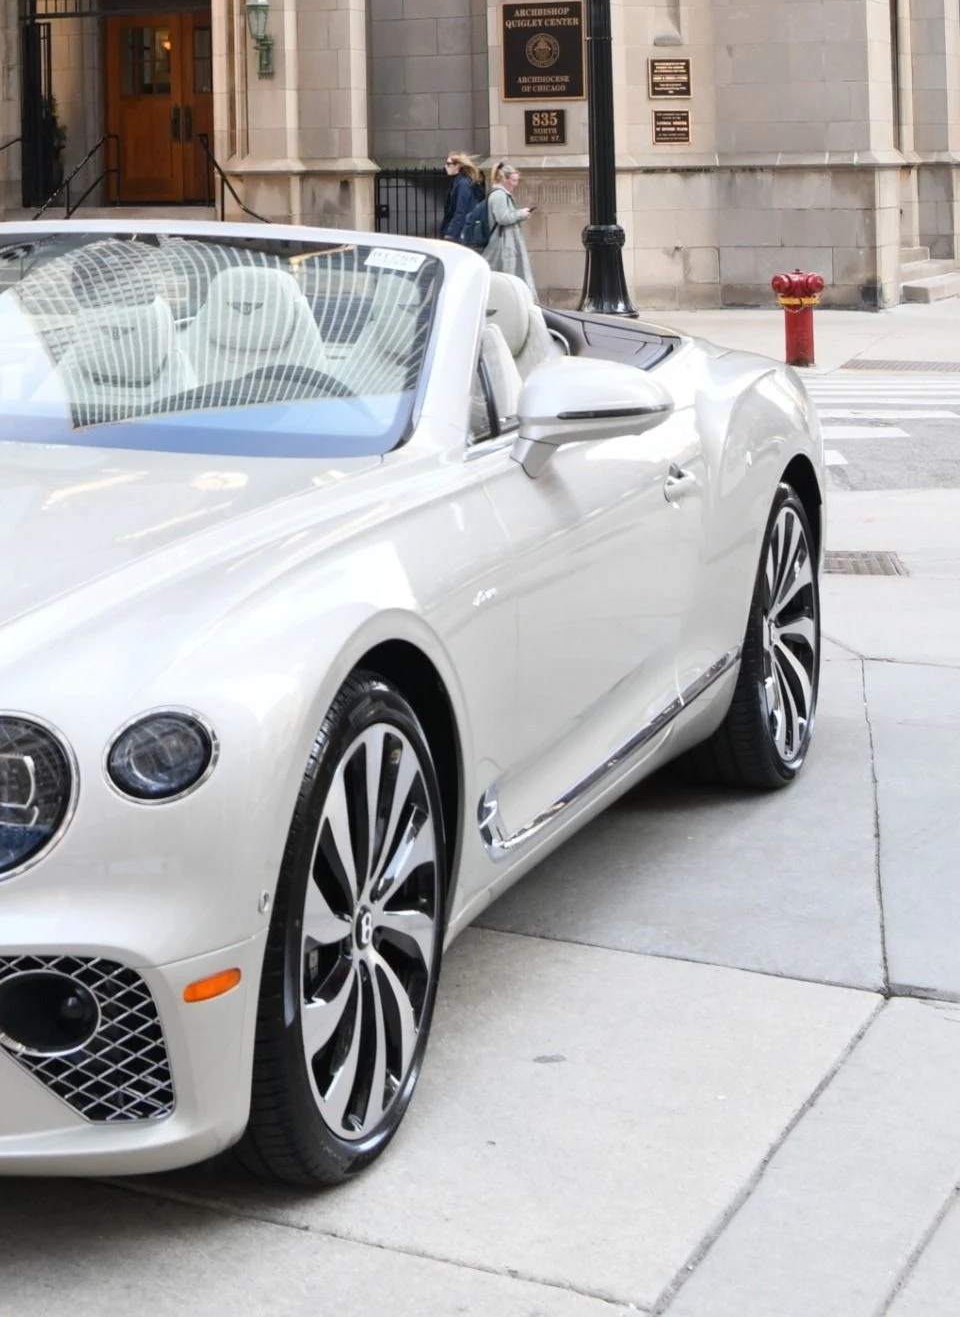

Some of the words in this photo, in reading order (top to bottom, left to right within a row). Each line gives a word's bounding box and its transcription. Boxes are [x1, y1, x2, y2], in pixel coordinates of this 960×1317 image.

[514, 7, 570, 17] ARCHBISHOP
[505, 19, 542, 29] QUIGLEY
[544, 17, 579, 26] CENTER
[517, 75, 570, 83] ARCHDIOCESE
[533, 84, 566, 92] CHICAGO
[532, 112, 558, 126] 835
